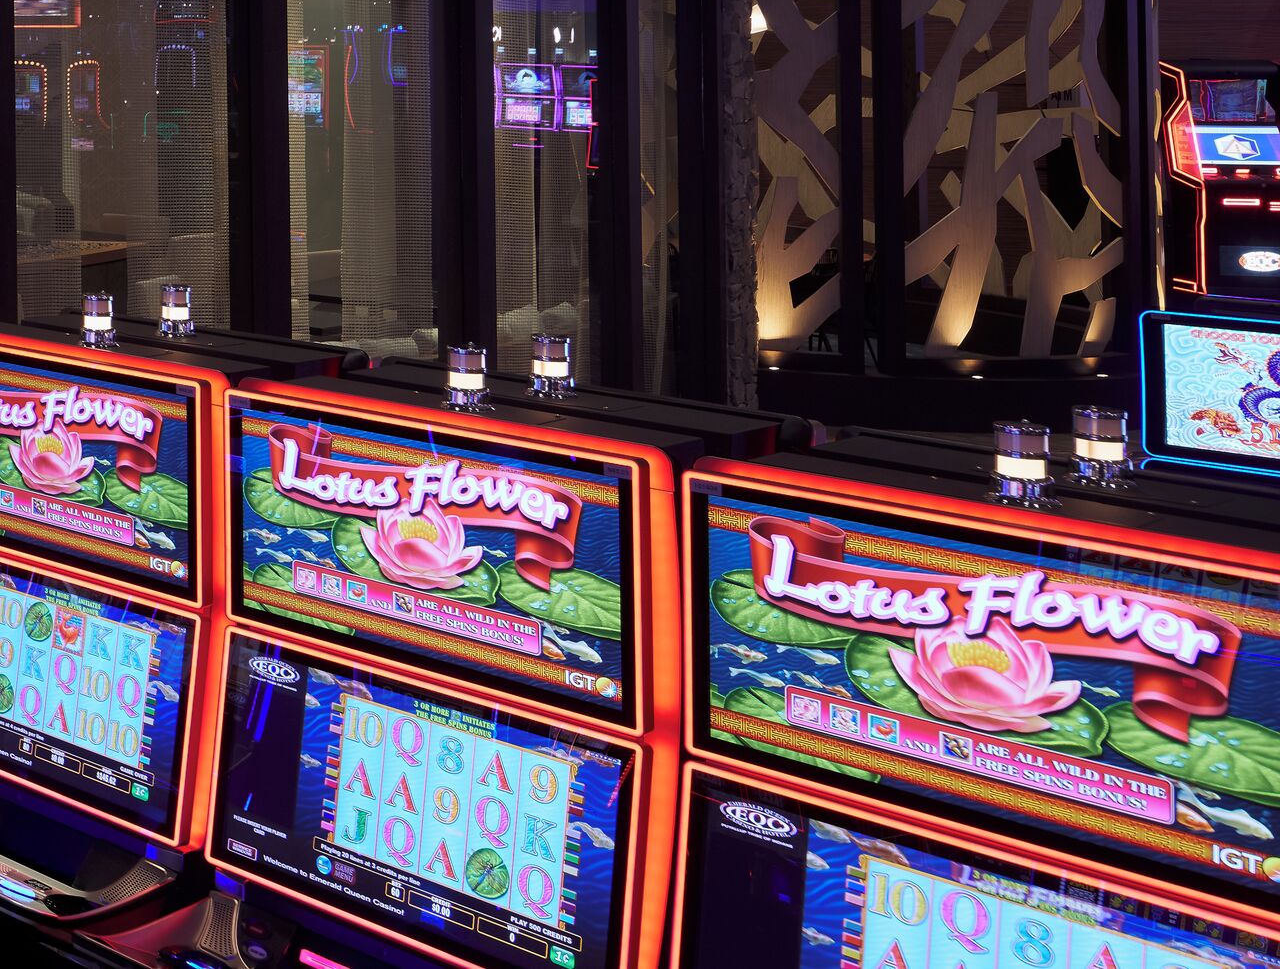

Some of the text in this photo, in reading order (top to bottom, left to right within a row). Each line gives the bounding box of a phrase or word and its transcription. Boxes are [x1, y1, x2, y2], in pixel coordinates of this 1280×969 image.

[1190, 329, 1246, 342] CHOOSE
[40, 386, 154, 441] Flower
[1250, 422, 1264, 443] 5
[279, 438, 569, 530] Lotus Flower
[14, 502, 131, 530] AND ARE ALL WILD IN THE
[48, 512, 123, 538] FREE SPINS BONUS!
[150, 556, 171, 573] IGT
[763, 535, 1220, 665] Lotus Flower
[368, 598, 536, 636] AND ARE ALL WILD IN THE
[416, 610, 524, 646] FREE SPINS BONUS!
[88, 623, 112, 661] K
[120, 632, 145, 671] K
[23, 645, 46, 682] K
[54, 654, 77, 695] Q
[80, 666, 111, 702] 10
[116, 675, 141, 718] Q
[566, 670, 596, 691] IGT
[19, 684, 138, 758] Q A 10 10
[414, 700, 495, 730] 3 OR MORE INITIATES
[416, 710, 492, 738] THE FREE SPINS BONUS
[345, 706, 559, 804] 10 Q 8 A 9
[902, 738, 1167, 800] AND ARE ALL WILD IN THE
[120, 766, 134, 776] GAME
[134, 771, 149, 781] OVER
[976, 756, 1148, 810] FREE SPINS BONUS!
[343, 758, 557, 862] A A 9 Q K
[320, 844, 342, 857] Playing
[342, 851, 349, 859] 20
[350, 854, 364, 865] lines
[376, 865, 397, 877] credits
[397, 873, 408, 882] per
[409, 876, 421, 886] line
[334, 862, 354, 875] GAME
[342, 806, 555, 919] J Q A Q
[1212, 844, 1265, 874] IGT
[263, 854, 298, 874] Welcome
[309, 872, 342, 891] Emerald
[344, 887, 371, 903] Queen
[372, 898, 405, 916] Casino!
[334, 870, 353, 883] MENU
[391, 887, 400, 898] 60
[432, 896, 451, 908] CREDIT
[432, 904, 451, 918] $0.00
[869, 872, 928, 926] 10
[940, 890, 990, 953] Q
[1012, 919, 1055, 967] 8
[510, 916, 572, 944] PLAY 500 CREDITS
[510, 933, 516, 942] 0
[554, 951, 570, 964] 1¢
